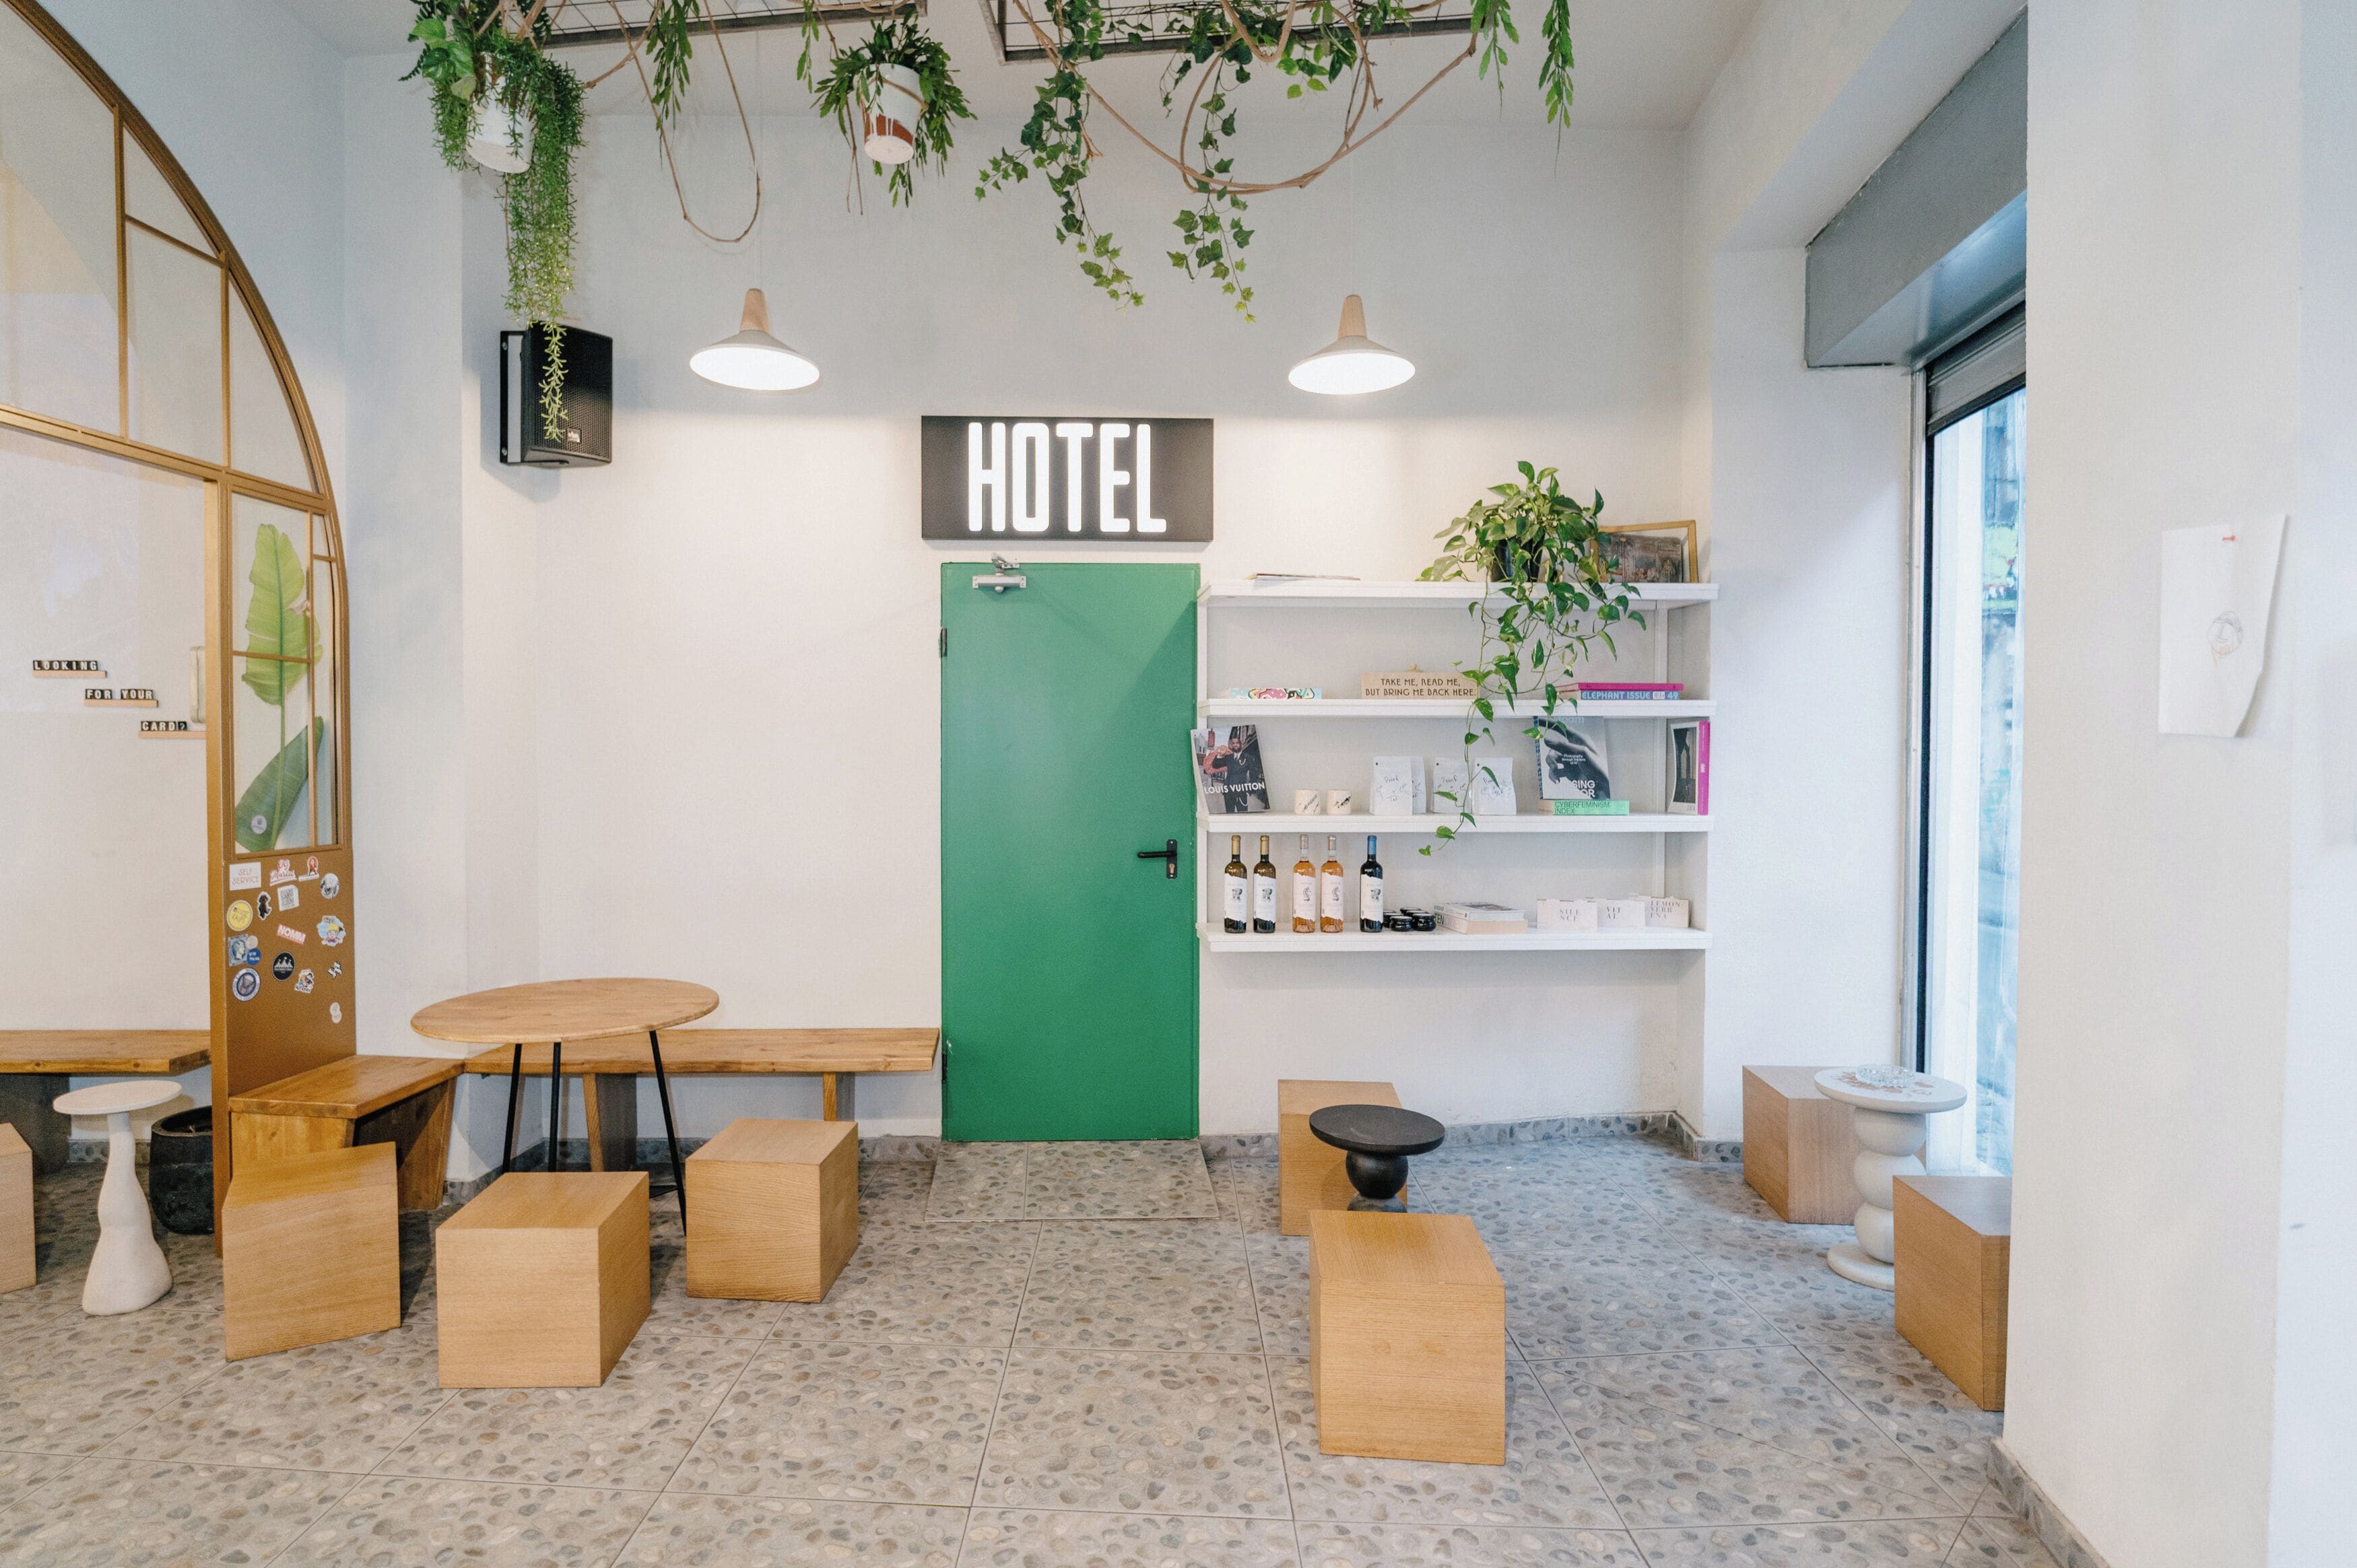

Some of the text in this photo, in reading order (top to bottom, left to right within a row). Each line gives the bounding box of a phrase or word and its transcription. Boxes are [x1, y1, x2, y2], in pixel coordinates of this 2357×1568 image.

[968, 421, 1167, 533] HOTEL
[34, 660, 98, 671] LOOKING
[1381, 678, 1461, 687] TAKE ME, READ ME,
[86, 689, 153, 700] FOR YOUR
[1384, 688, 1409, 696] BRING
[1413, 688, 1424, 696] ME
[1428, 688, 1449, 696] BACK
[1453, 688, 1476, 696] HERE.
[1582, 691, 1678, 700] ELEPHANT ISSUE 49
[141, 721, 187, 731] CARD?
[1204, 782, 1265, 794] LOUIS VUITTON
[238, 868, 253, 876] SELF
[232, 876, 259, 885] SERVICE
